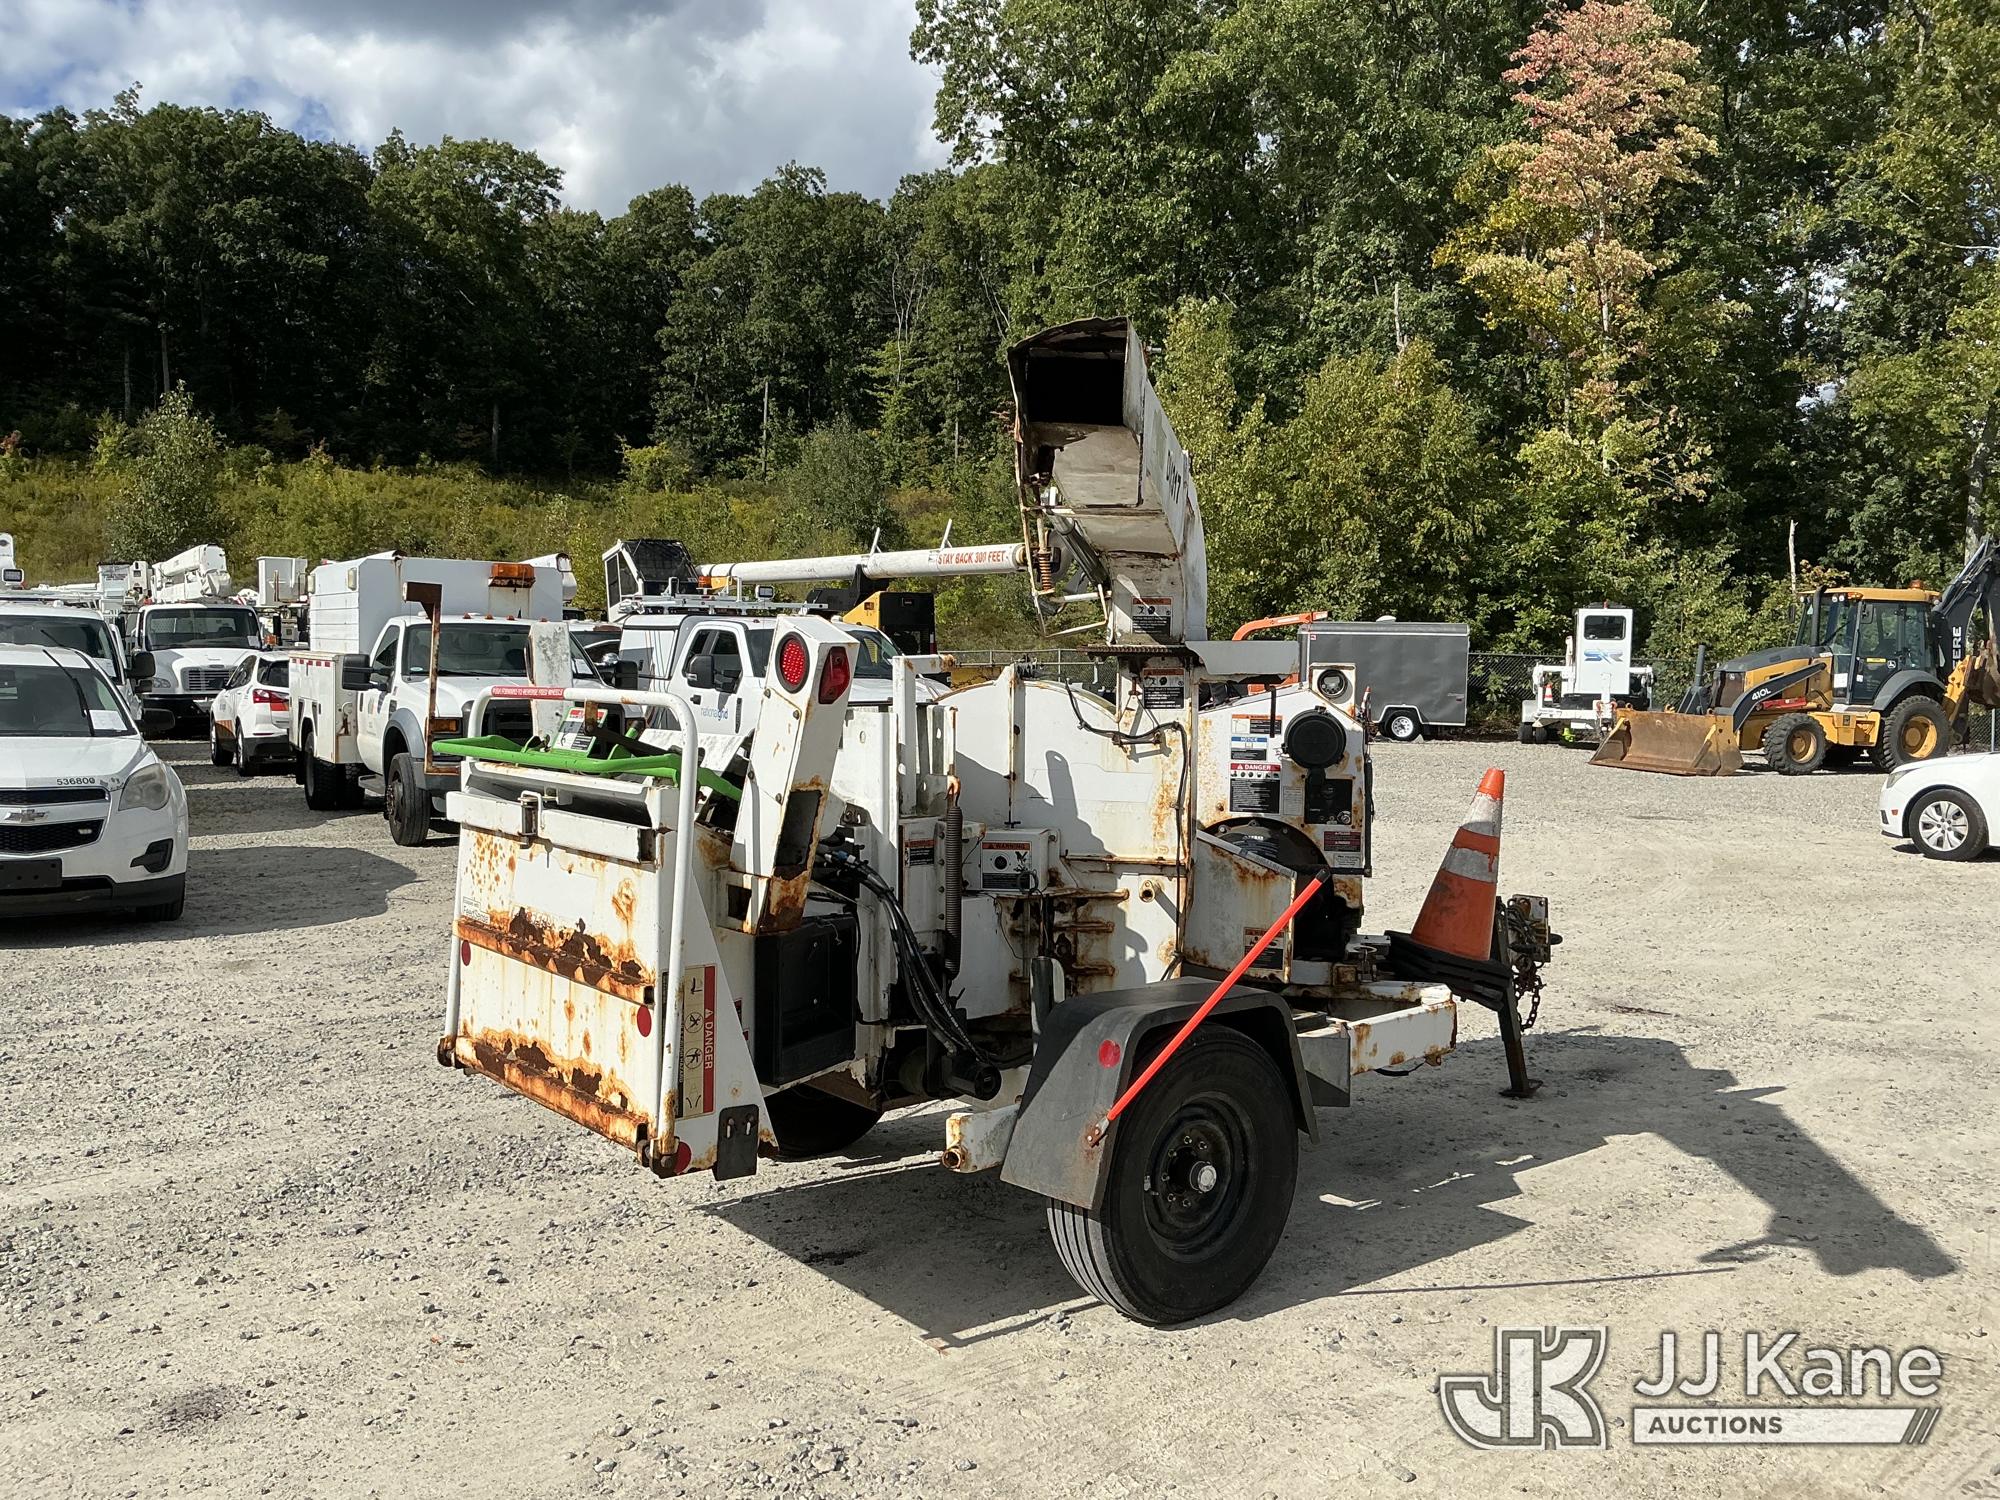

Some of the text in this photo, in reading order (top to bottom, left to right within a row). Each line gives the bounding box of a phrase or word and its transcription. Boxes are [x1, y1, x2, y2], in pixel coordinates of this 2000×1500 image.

[938, 550, 1006, 565] STAY BACK 300 FEET
[1751, 687, 1771, 701] 410L
[1244, 763, 1271, 771] DANGER
[704, 1020, 714, 1070] DANGER
